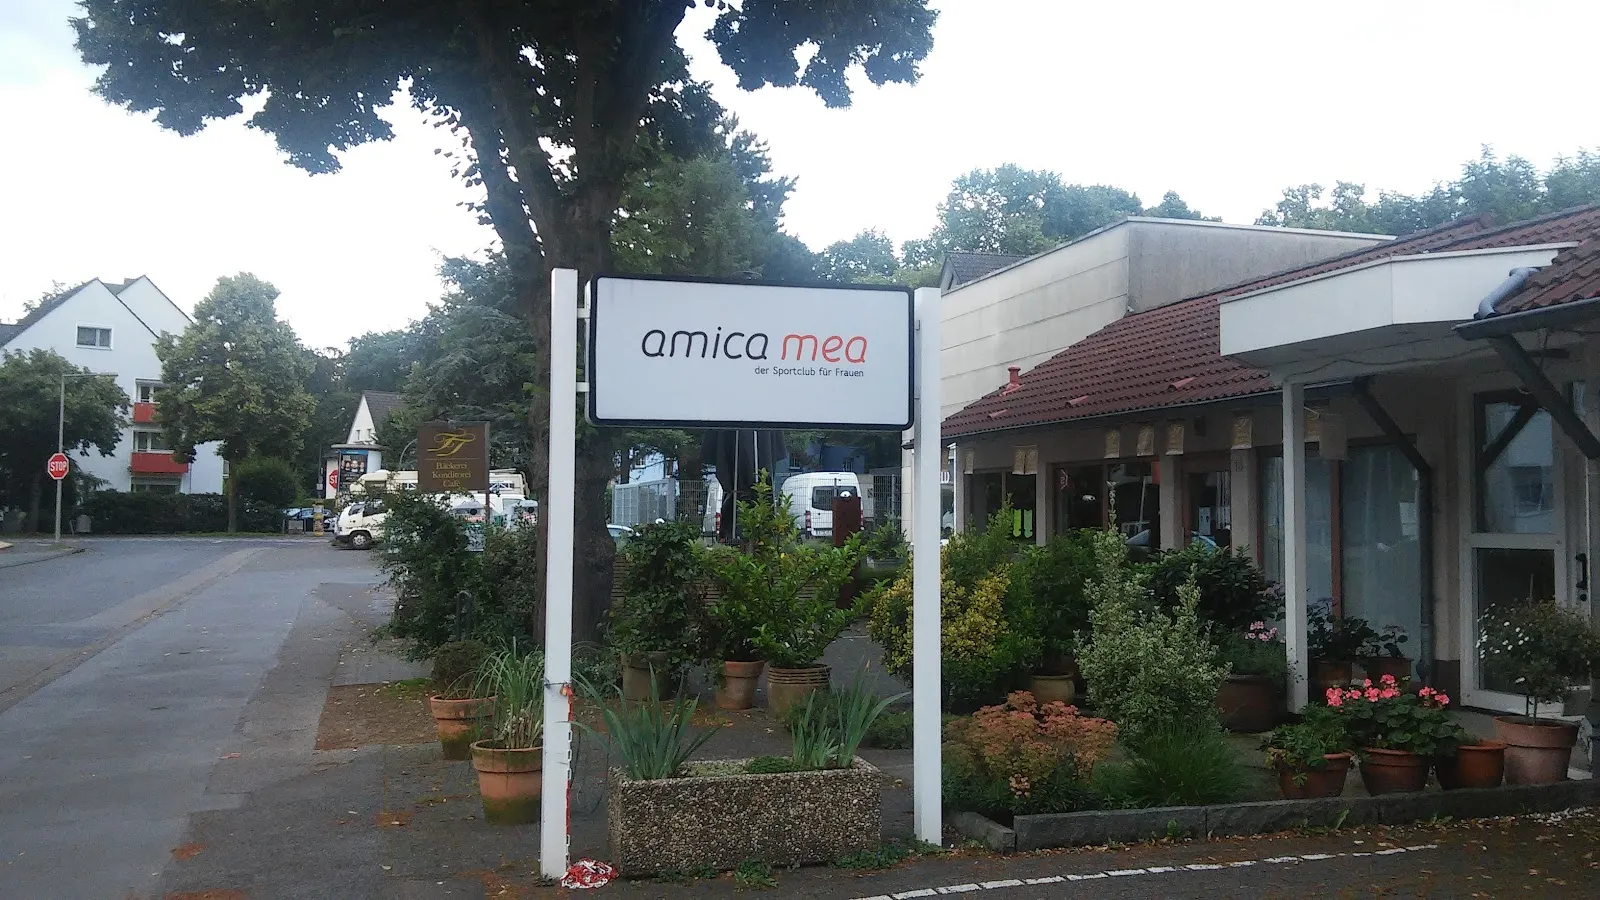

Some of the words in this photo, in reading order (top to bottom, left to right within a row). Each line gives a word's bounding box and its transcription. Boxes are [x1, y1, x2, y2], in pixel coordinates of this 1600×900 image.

[641, 326, 769, 360] amica
[781, 334, 868, 363] mea
[754, 366, 769, 375] der
[773, 366, 816, 377] Sportclub
[819, 367, 832, 376] für
[835, 368, 864, 377] Frauen
[50, 461, 67, 471] STOP
